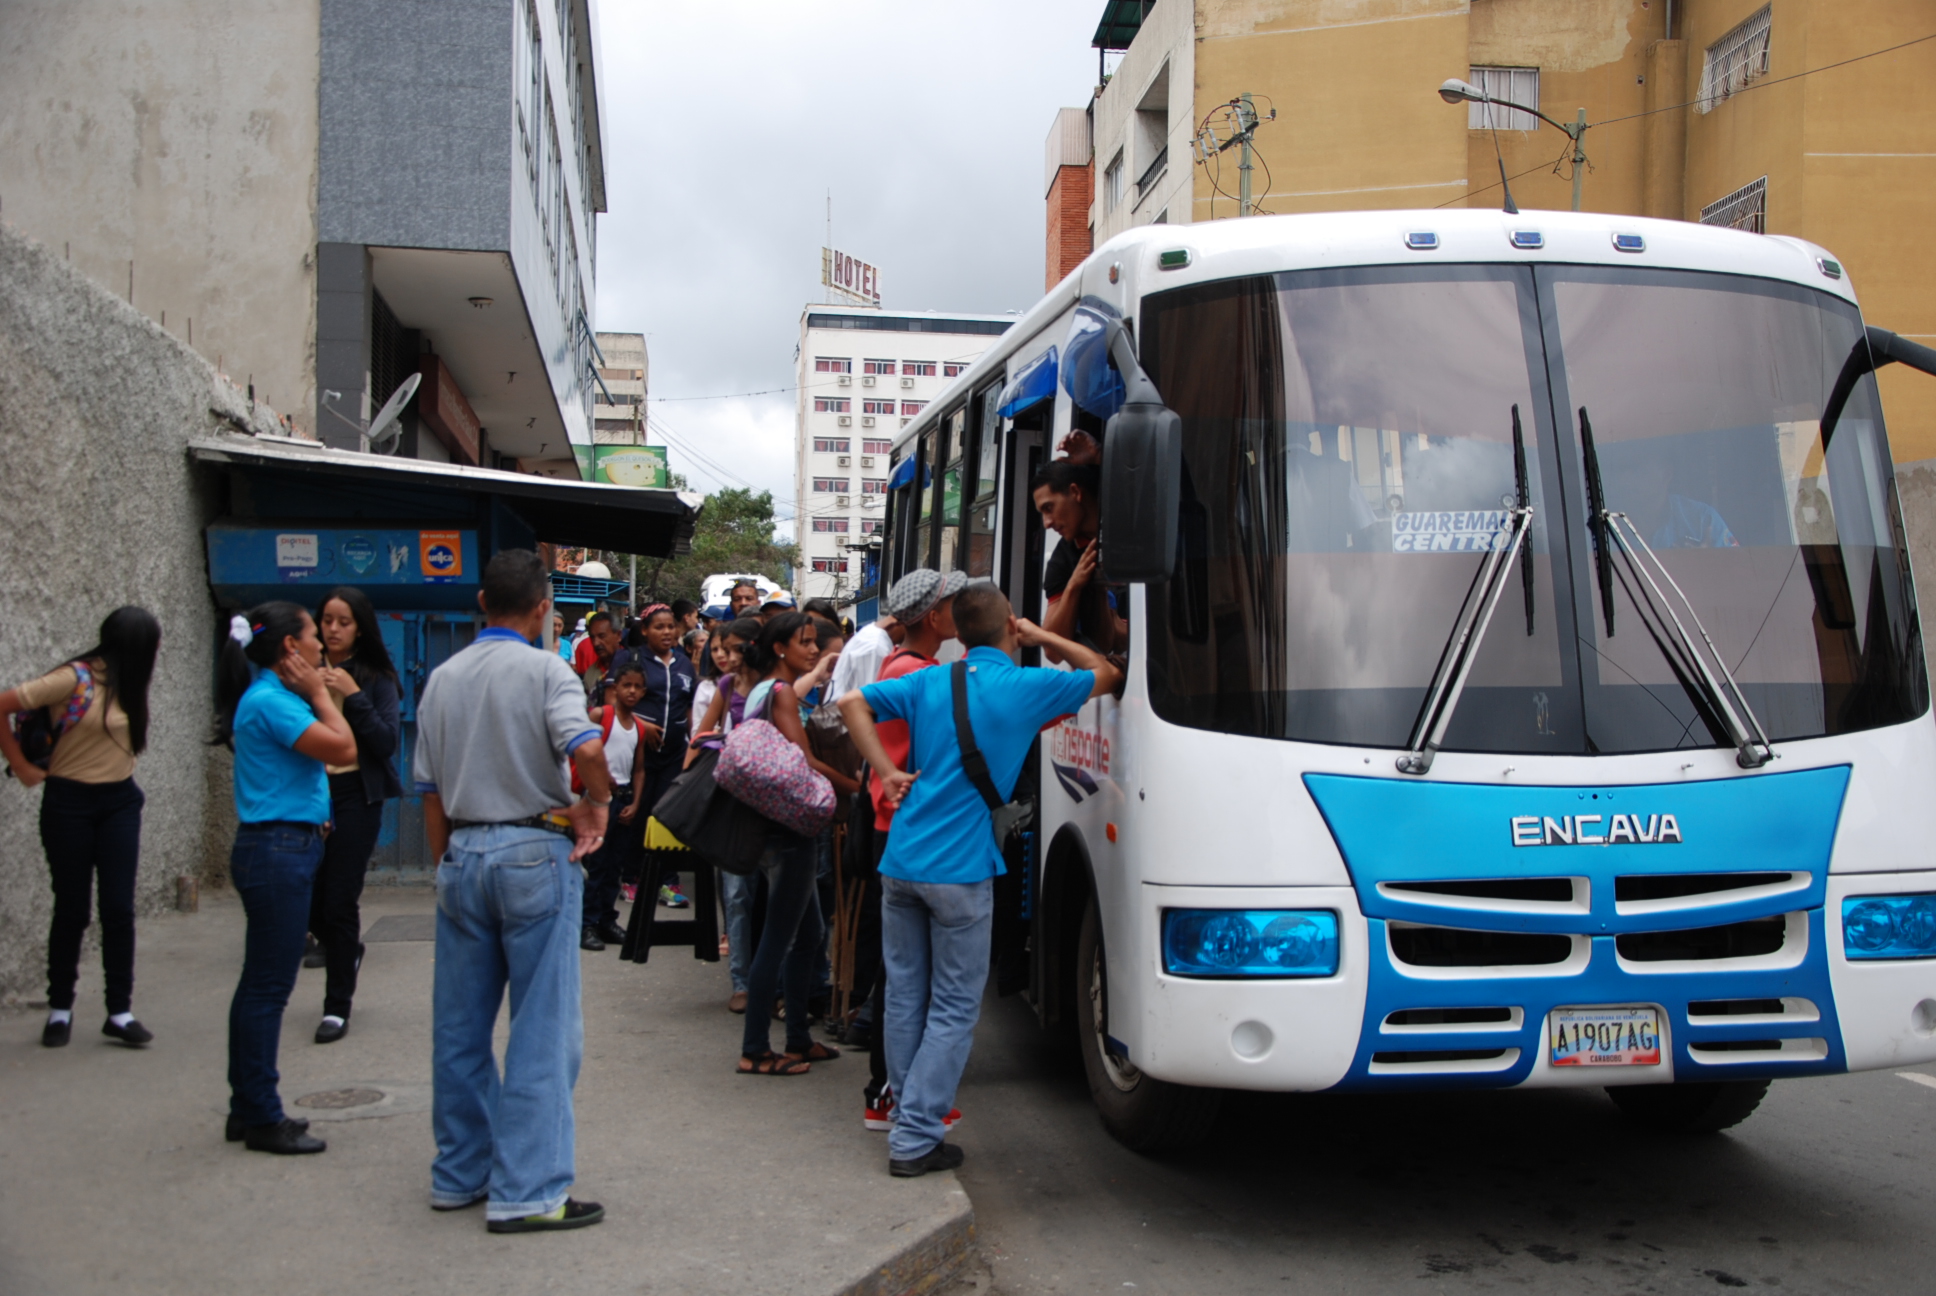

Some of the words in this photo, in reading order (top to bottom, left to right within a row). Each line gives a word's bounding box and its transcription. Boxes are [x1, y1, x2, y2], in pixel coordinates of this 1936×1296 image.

[834, 249, 881, 300] HOTEL
[1394, 532, 1513, 551] CENTRO
[1557, 1022, 1653, 1053] A1907AG
[1590, 1055, 1622, 1063] CARABOBO
